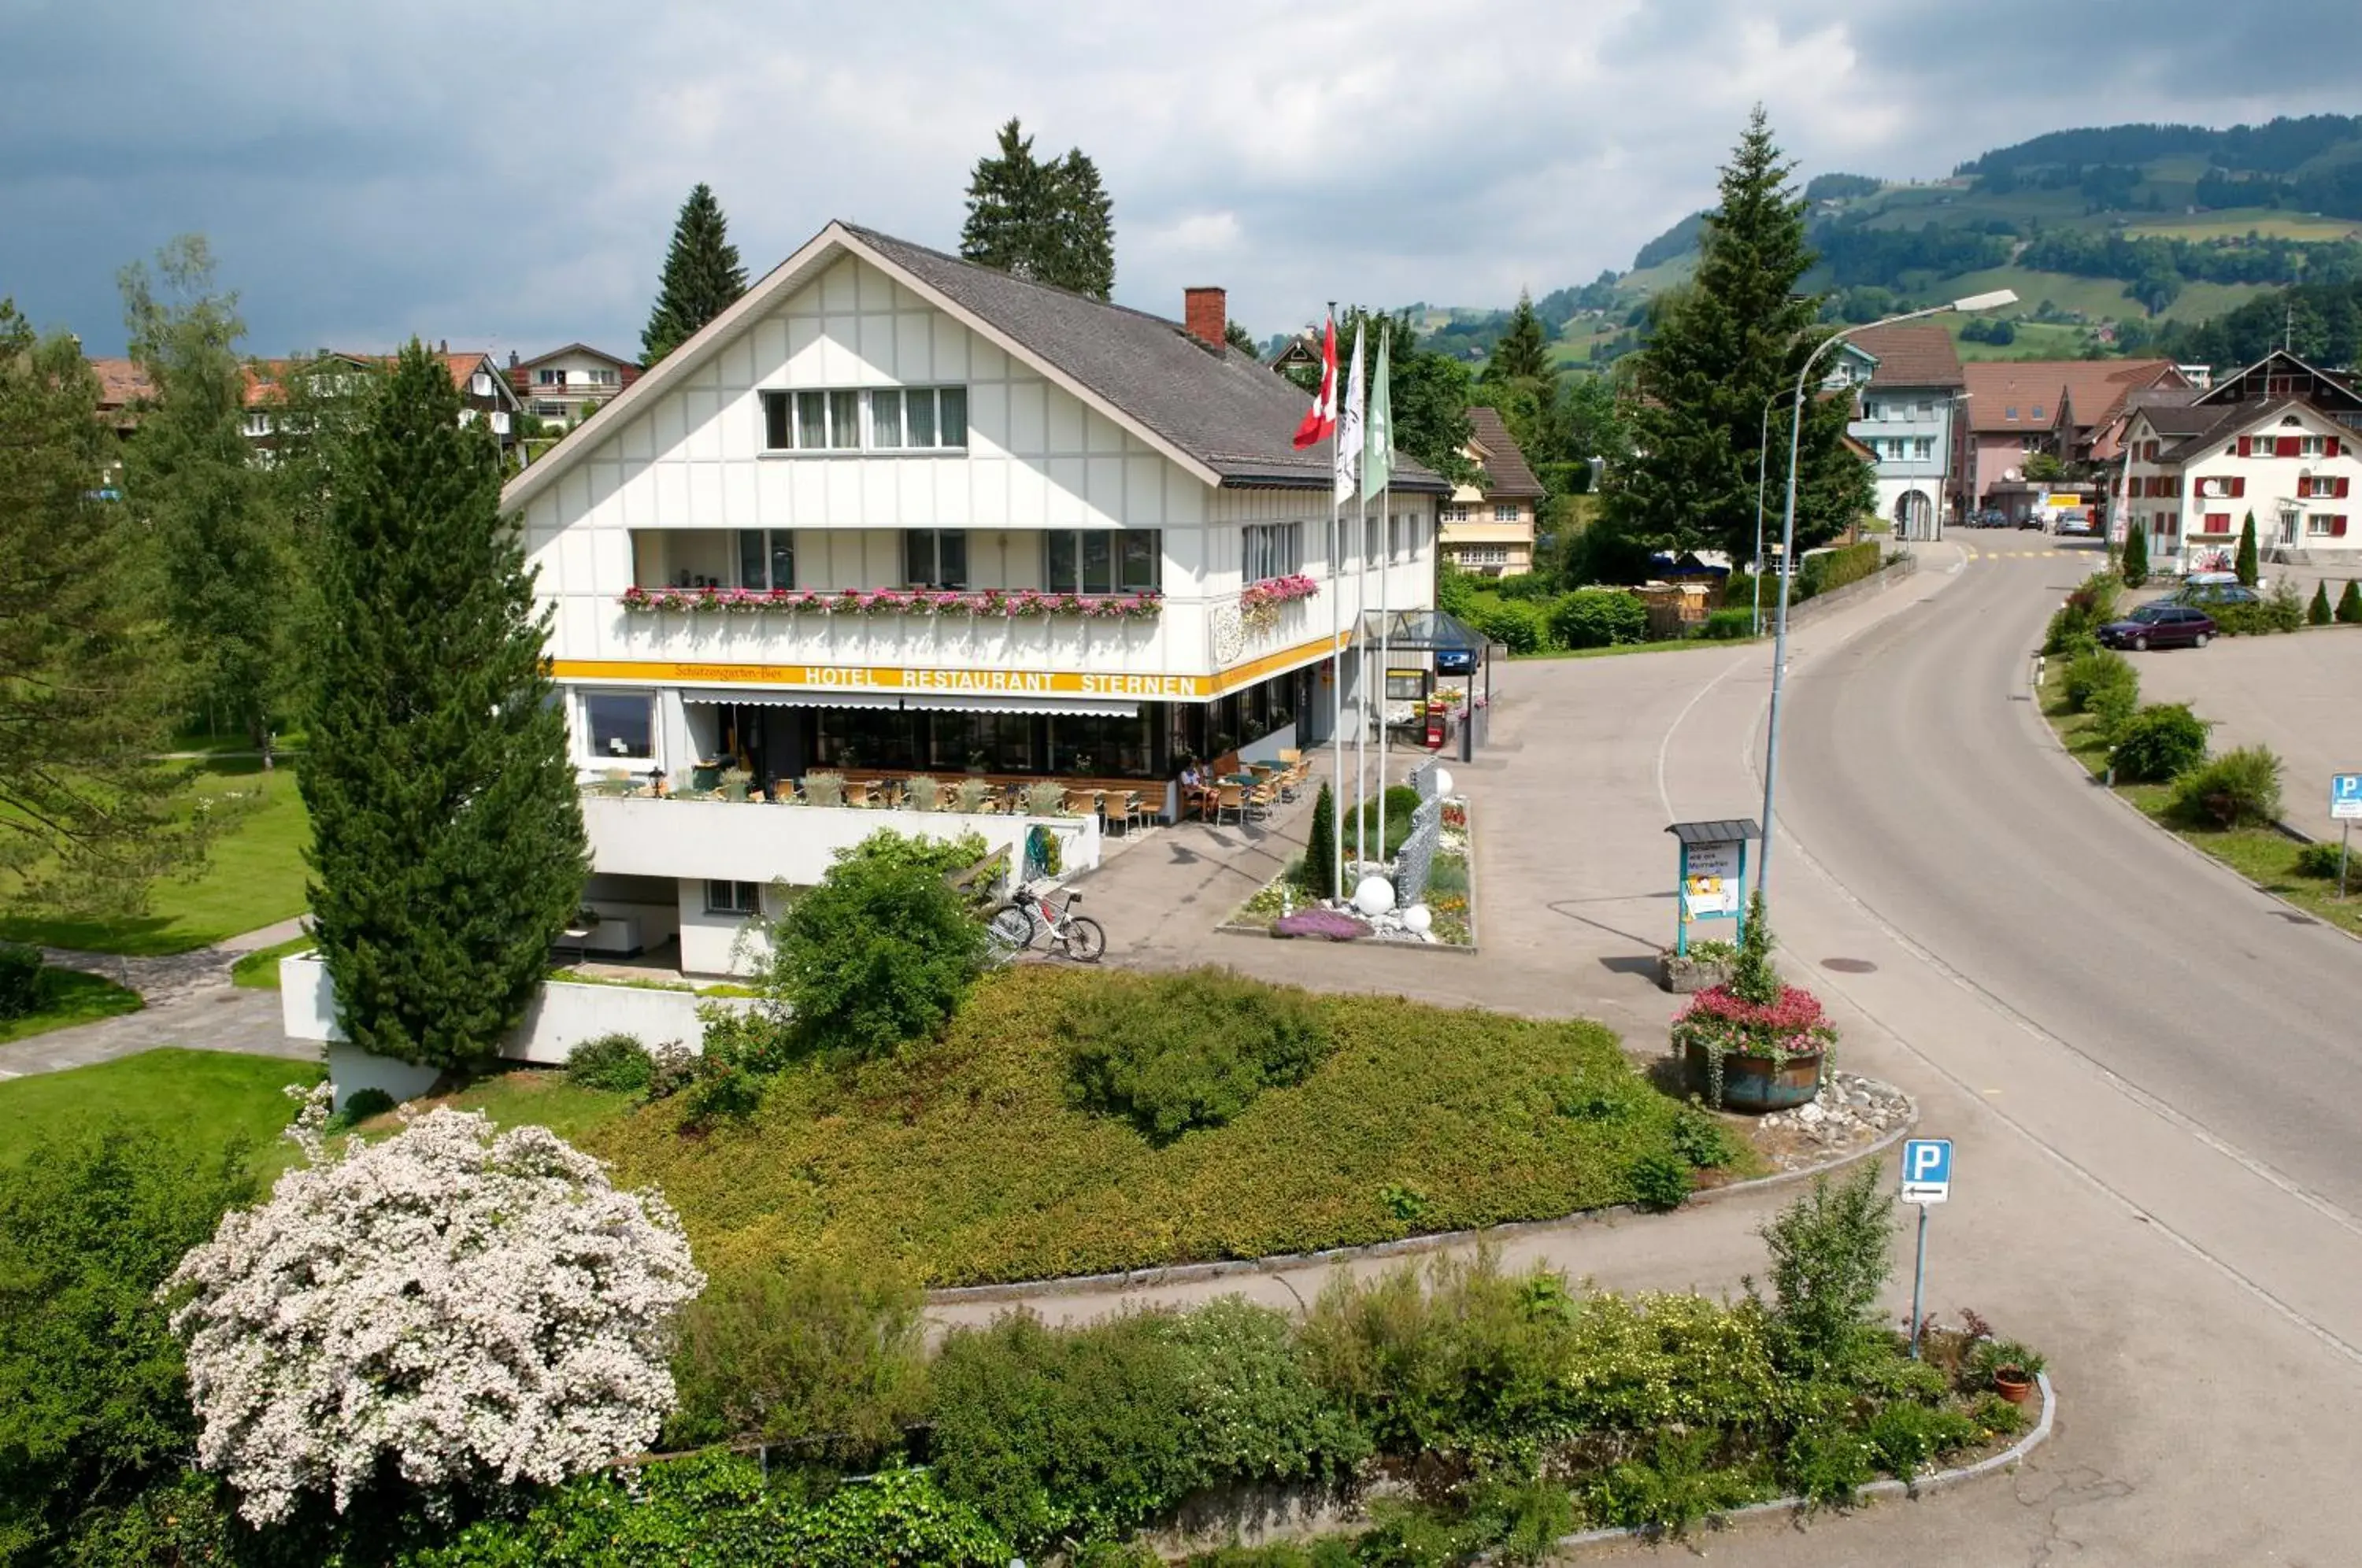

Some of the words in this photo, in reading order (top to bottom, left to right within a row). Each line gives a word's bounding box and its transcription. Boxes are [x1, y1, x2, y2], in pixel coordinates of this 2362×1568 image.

[806, 668, 877, 686] HOTEL
[903, 670, 1055, 692] RESTAURANT
[1081, 675, 1196, 696] STERNEN
[2342, 778, 2356, 797] P
[1915, 1145, 1941, 1179] P
